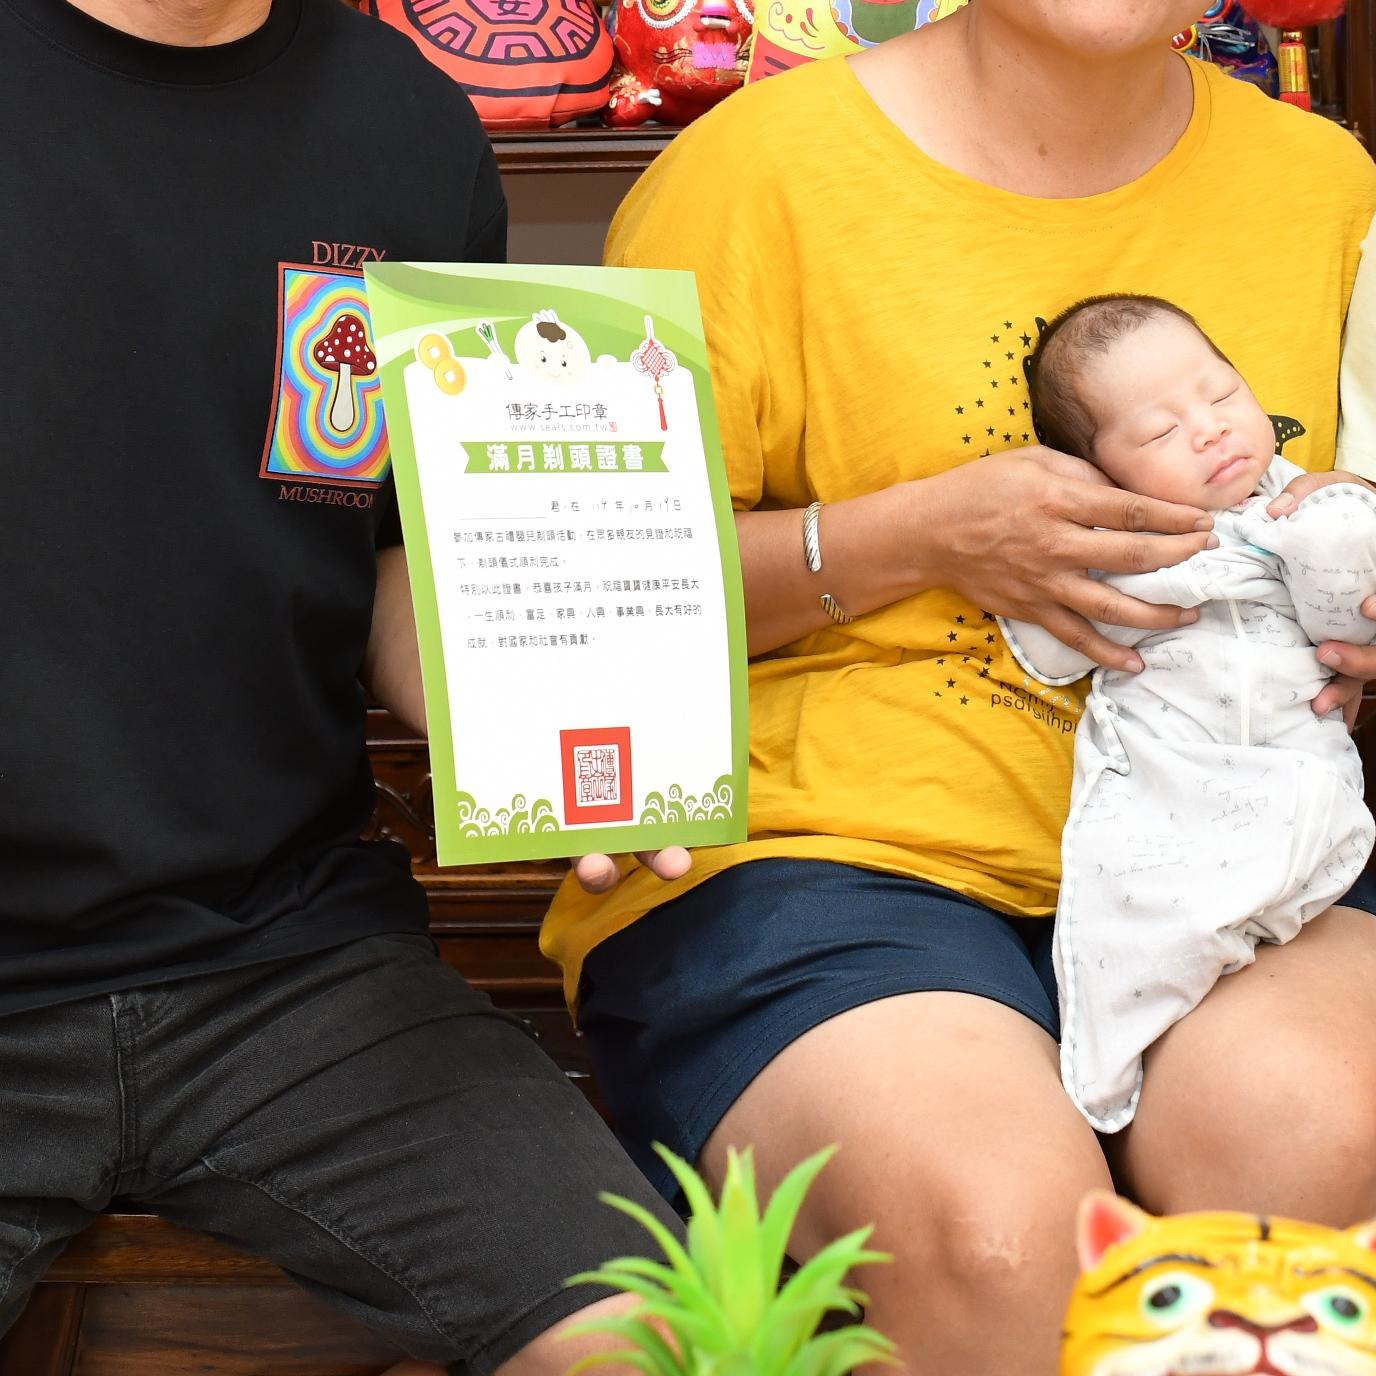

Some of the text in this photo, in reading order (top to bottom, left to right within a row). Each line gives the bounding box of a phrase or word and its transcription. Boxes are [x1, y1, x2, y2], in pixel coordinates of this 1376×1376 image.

[505, 402, 609, 422] 傳家手工印章
[510, 422, 608, 433] www.seals.com.tw
[485, 443, 644, 472] 滿月剃頭證書
[278, 485, 375, 509] MUSHROO
